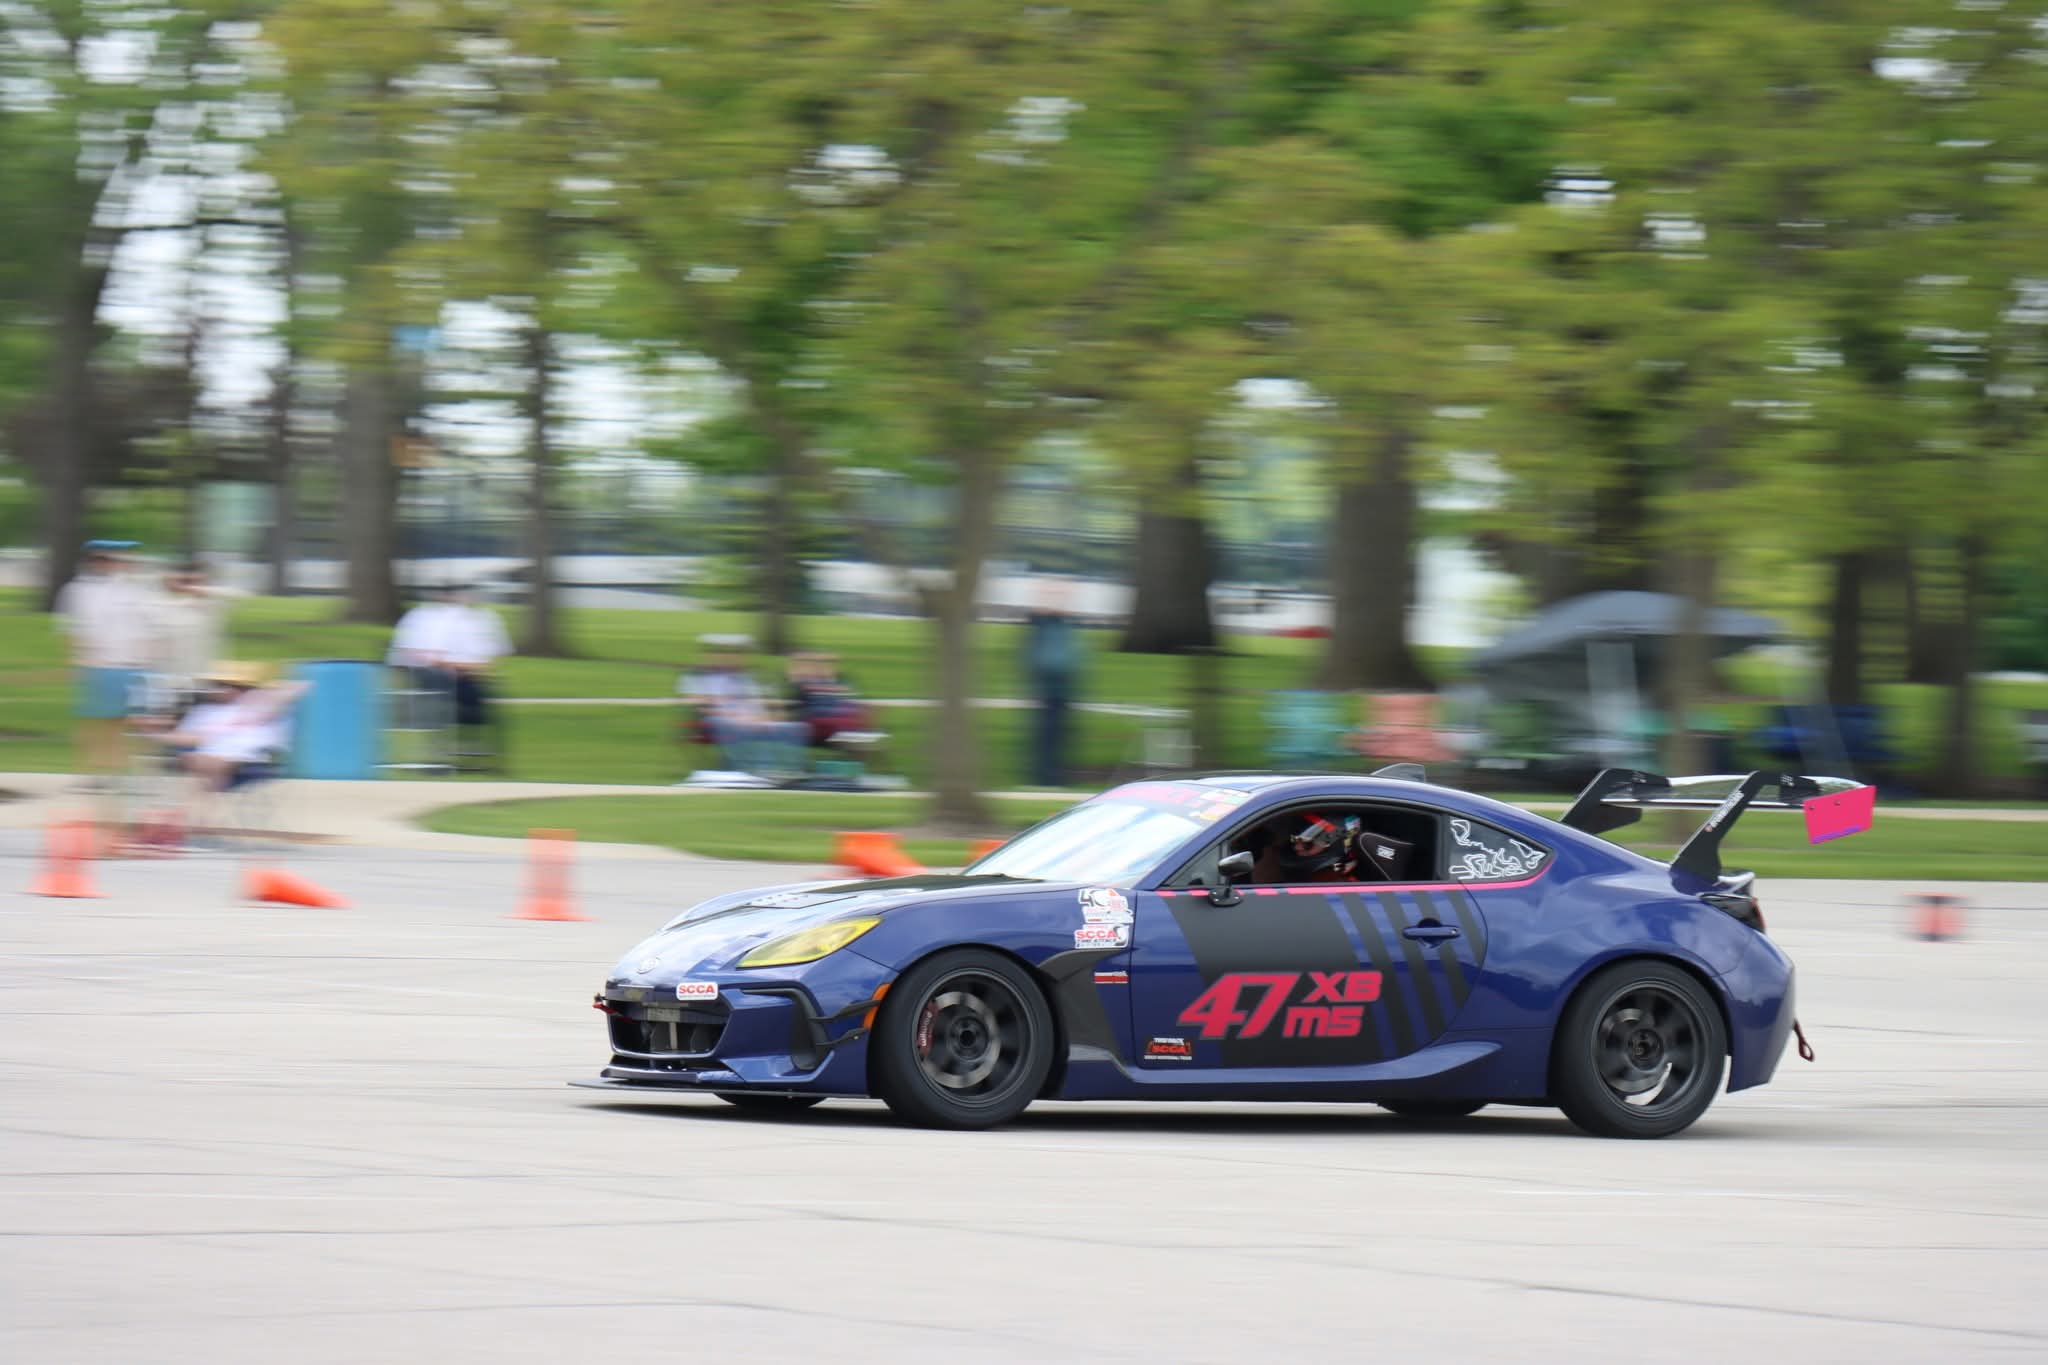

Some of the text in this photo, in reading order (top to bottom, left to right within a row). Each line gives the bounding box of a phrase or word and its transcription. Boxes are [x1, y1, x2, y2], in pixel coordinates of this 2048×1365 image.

[1076, 929, 1118, 939] SCCA
[679, 984, 715, 994] SCCA
[1177, 970, 1383, 1040] 47 XB
[1151, 1045, 1186, 1054] SCCA
